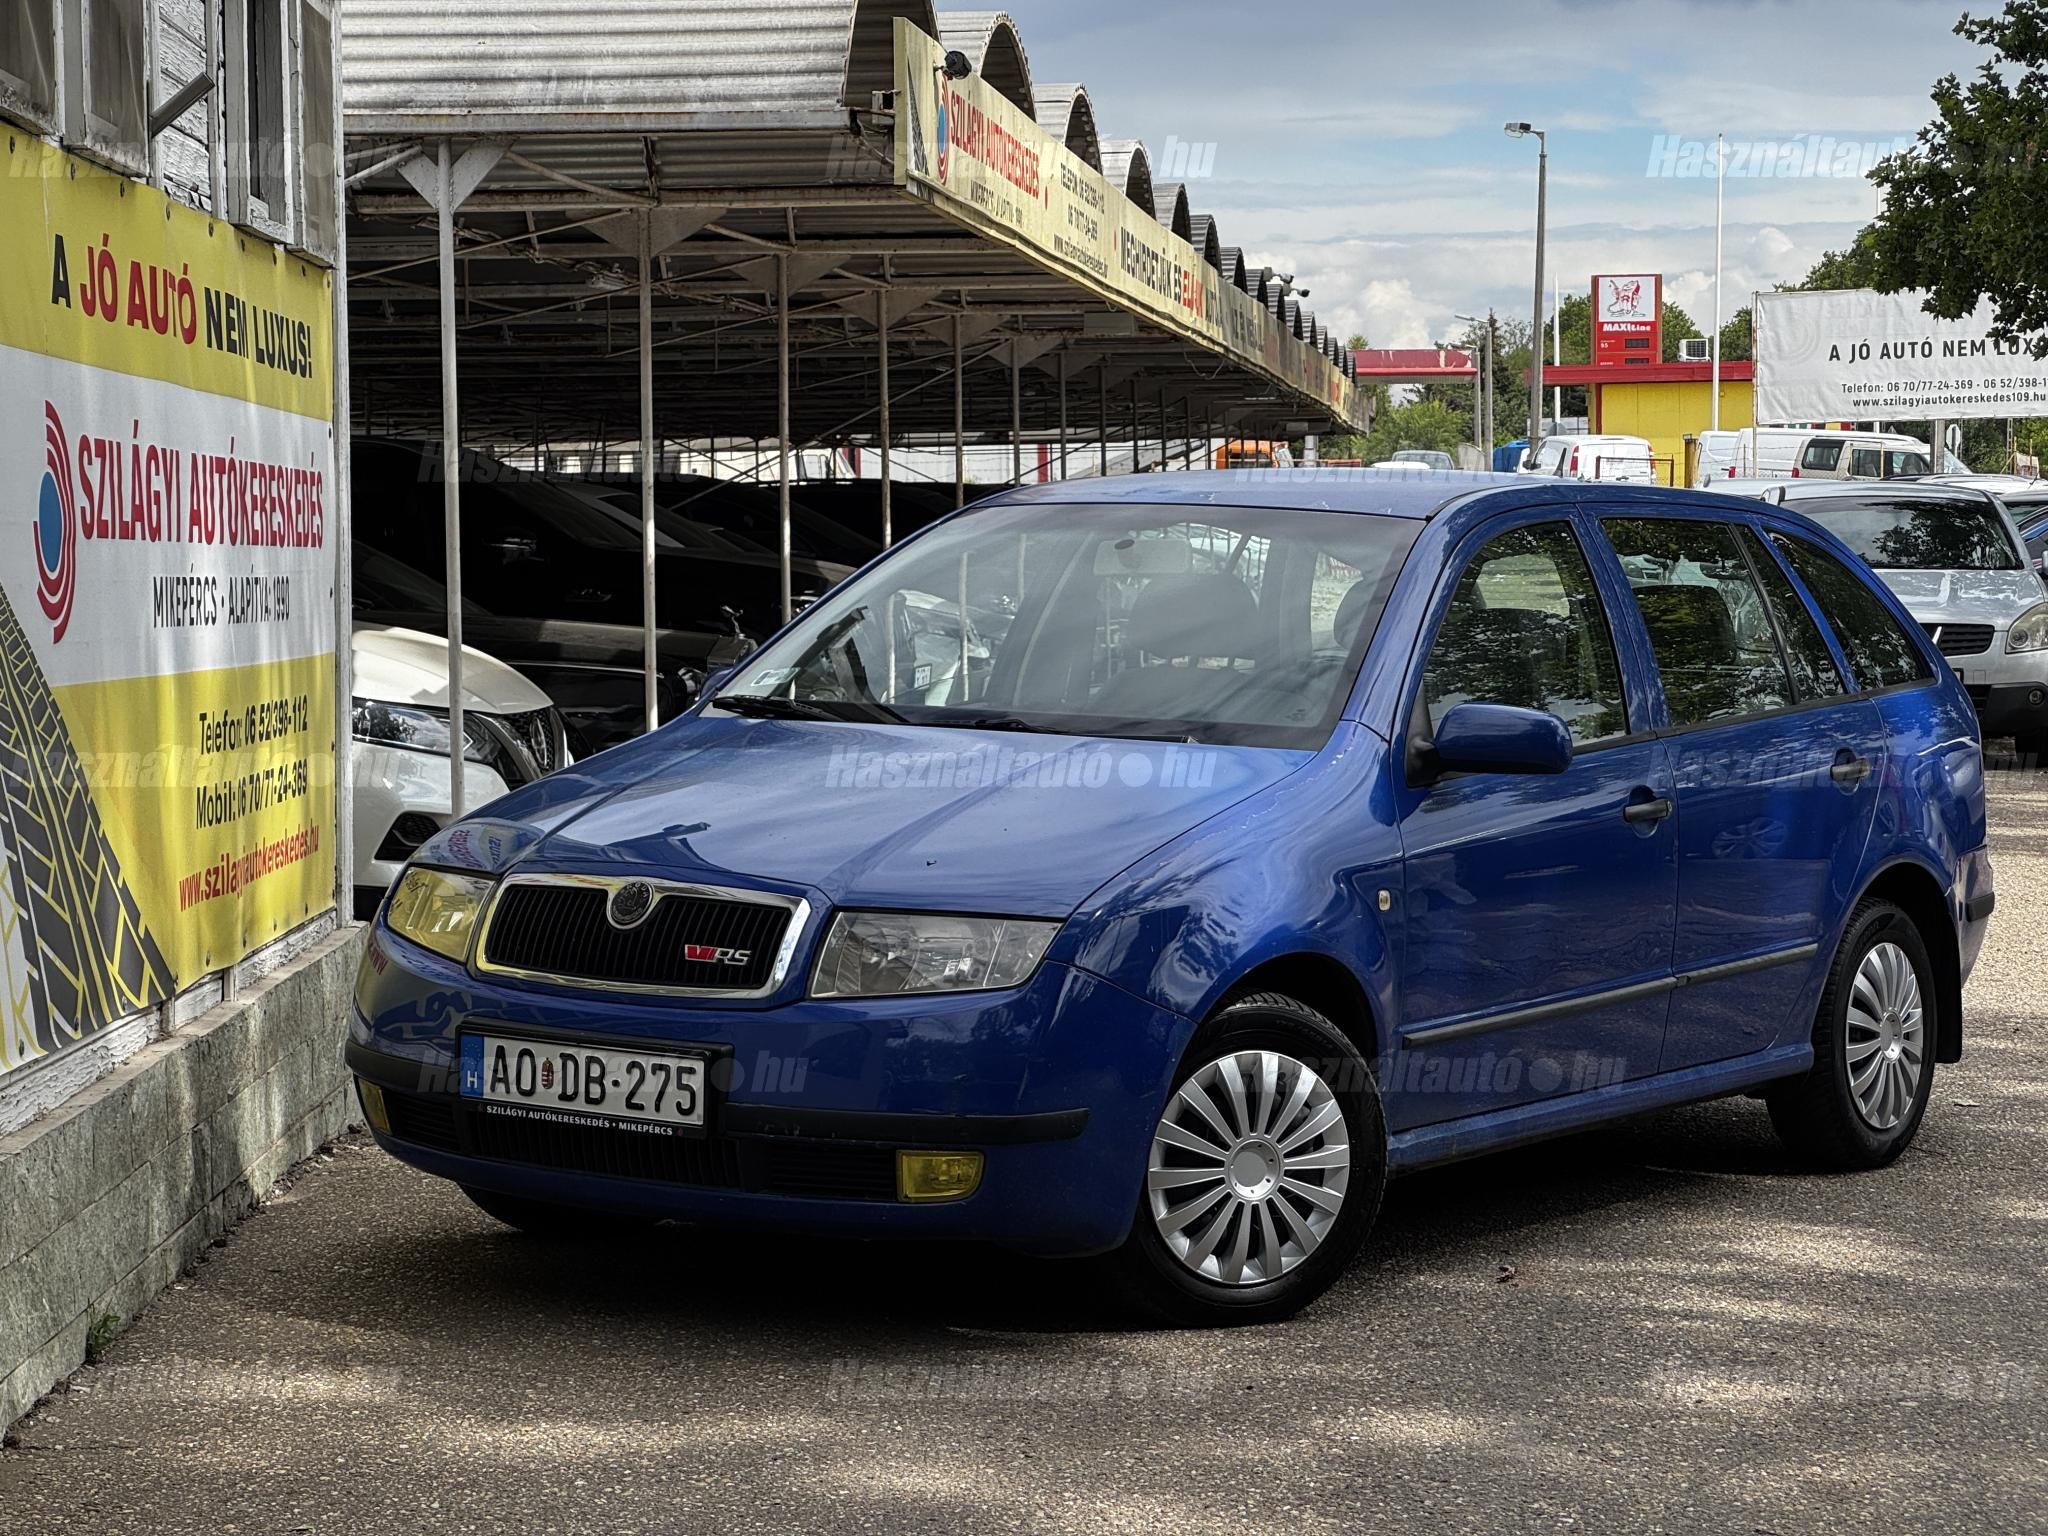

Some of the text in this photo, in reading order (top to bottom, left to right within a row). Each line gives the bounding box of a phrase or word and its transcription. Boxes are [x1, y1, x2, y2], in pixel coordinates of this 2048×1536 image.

[52, 233, 313, 379] A JÓ AUTÓ NEM LUXUS!
[1829, 336, 2048, 364] A JÓ AUTÓ NEM LUX
[1841, 383, 1884, 394] Telefon:
[1887, 382, 1900, 392] 06
[1903, 379, 1973, 393] 70/77-24-369
[1983, 378, 1997, 389] 06
[1852, 391, 2046, 408] www.szilagyiautokereskedes109.hu
[78, 419, 324, 549] SZILÁGYI AUTÓKERESKEDÉS
[153, 563, 217, 629] MIKEPÉRCS
[244, 704, 256, 746] 06
[196, 781, 236, 830] Mobil:
[237, 776, 247, 819] 06
[466, 1070, 478, 1089] H
[489, 1044, 537, 1098] AO
[486, 1104, 673, 1137] SZILÁGYI AUTÓKERESKEDÉS MIKEPÉRCS
